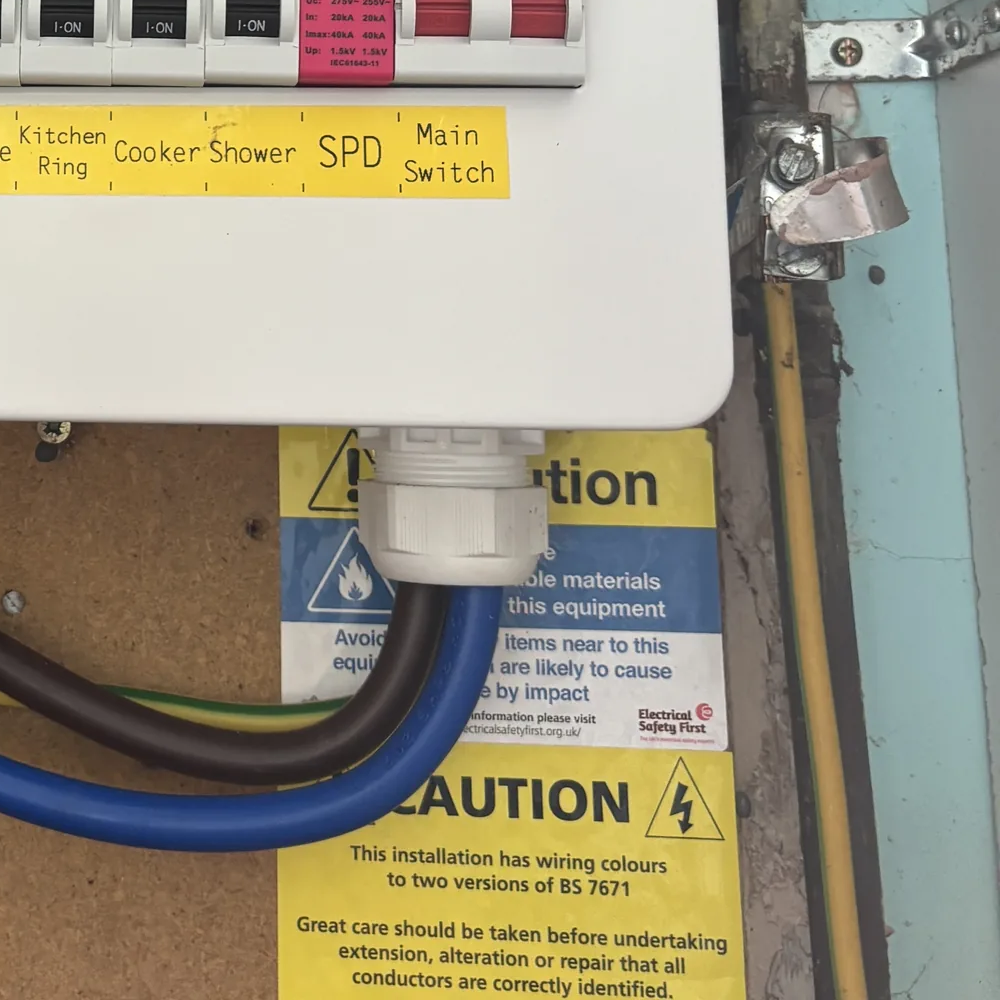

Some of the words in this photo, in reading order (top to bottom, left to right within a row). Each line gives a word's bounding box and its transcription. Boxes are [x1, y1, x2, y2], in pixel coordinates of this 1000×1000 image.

[20, 126, 106, 145] Kitchen
[417, 124, 479, 146] Main
[114, 141, 201, 164] Cooker
[209, 141, 297, 164] Shower
[319, 135, 382, 169] SPD
[39, 157, 88, 180] Ring
[404, 160, 495, 184] Switch
[562, 572, 661, 591] materials
[508, 597, 547, 615] this
[553, 600, 666, 620] equipment
[504, 633, 556, 652] items
[562, 636, 604, 652] near
[609, 636, 628, 654] to
[634, 637, 669, 655] this
[333, 653, 378, 674] equi
[501, 661, 530, 675] are
[536, 659, 584, 680] likely
[590, 661, 608, 677] to
[614, 663, 672, 679] cause
[496, 682, 518, 703] by
[525, 683, 589, 704] impact
[537, 712, 571, 724] please
[574, 714, 596, 724] visit
[639, 709, 692, 720] Electrical
[639, 721, 676, 735] Safety
[680, 722, 706, 733] First
[393, 774, 630, 823] AUTION
[350, 845, 386, 862] This
[393, 846, 493, 866] installation
[499, 850, 530, 868] has
[535, 853, 594, 874] wiring
[601, 855, 667, 874] colours
[387, 872, 406, 888] to
[412, 874, 448, 889] two
[454, 875, 529, 893] versions
[534, 876, 554, 894] of
[561, 879, 582, 895] BS
[588, 880, 630, 897] 7671
[297, 916, 346, 934] Great
[352, 921, 388, 936] care
[394, 920, 456, 939] should
[462, 923, 484, 940] be
[489, 924, 541, 943] taken
[547, 926, 608, 945] before
[614, 930, 727, 955] undertaking
[339, 944, 433, 965] extension,
[439, 947, 529, 968] alteration
[535, 952, 555, 968] or
[561, 954, 614, 974] repair
[620, 955, 658, 974] that
[664, 956, 685, 974] all
[352, 969, 453, 989] conductors
[459, 975, 487, 990] are
[493, 974, 572, 997] correctly
[578, 978, 673, 999] identified.
